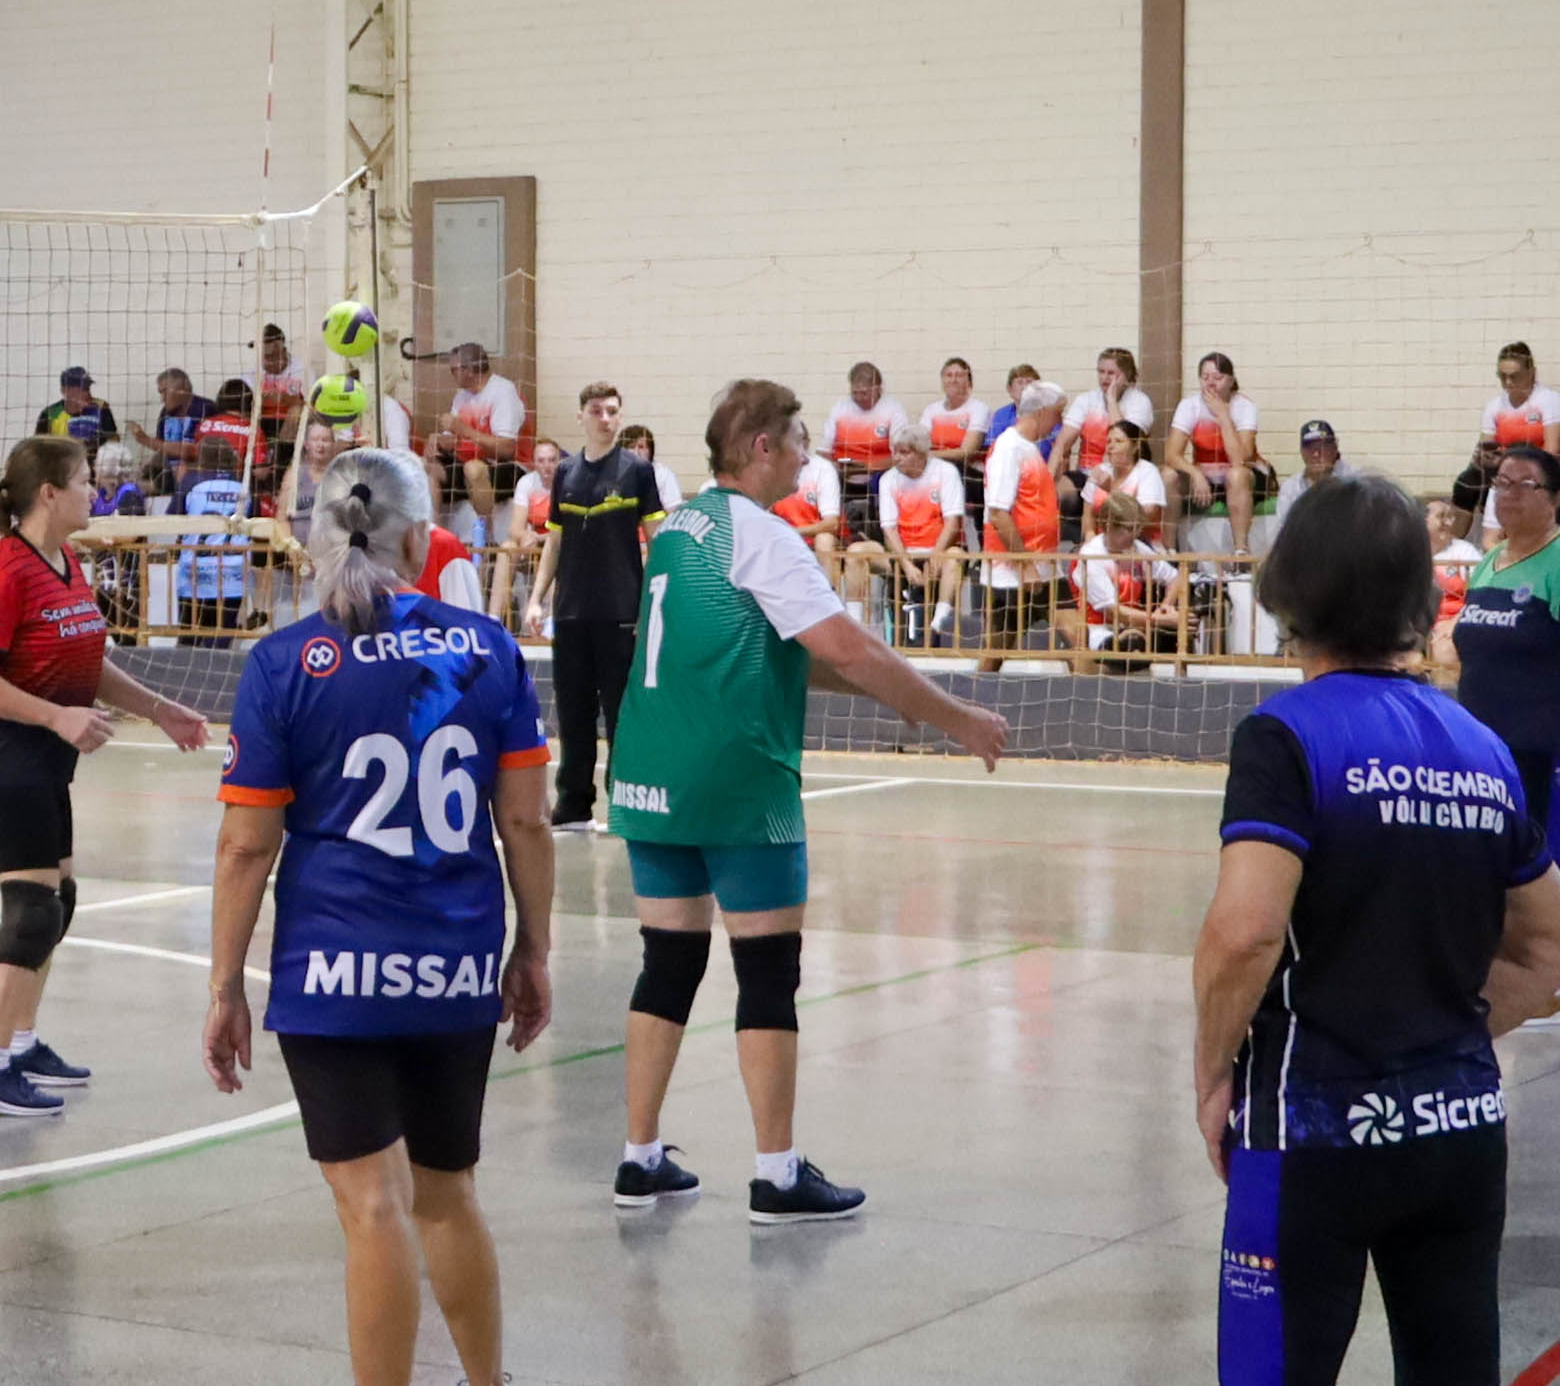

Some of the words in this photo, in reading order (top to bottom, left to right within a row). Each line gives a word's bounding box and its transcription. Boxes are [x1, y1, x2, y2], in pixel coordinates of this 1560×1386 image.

[652, 507, 717, 545] OLEIBOL
[352, 626, 491, 664] CRESOL
[643, 572, 670, 689] 1
[341, 723, 481, 857] 26
[1345, 758, 1413, 795] SÃO
[1414, 766, 1517, 812] CLEMENT
[303, 950, 496, 1000] MISSAL
